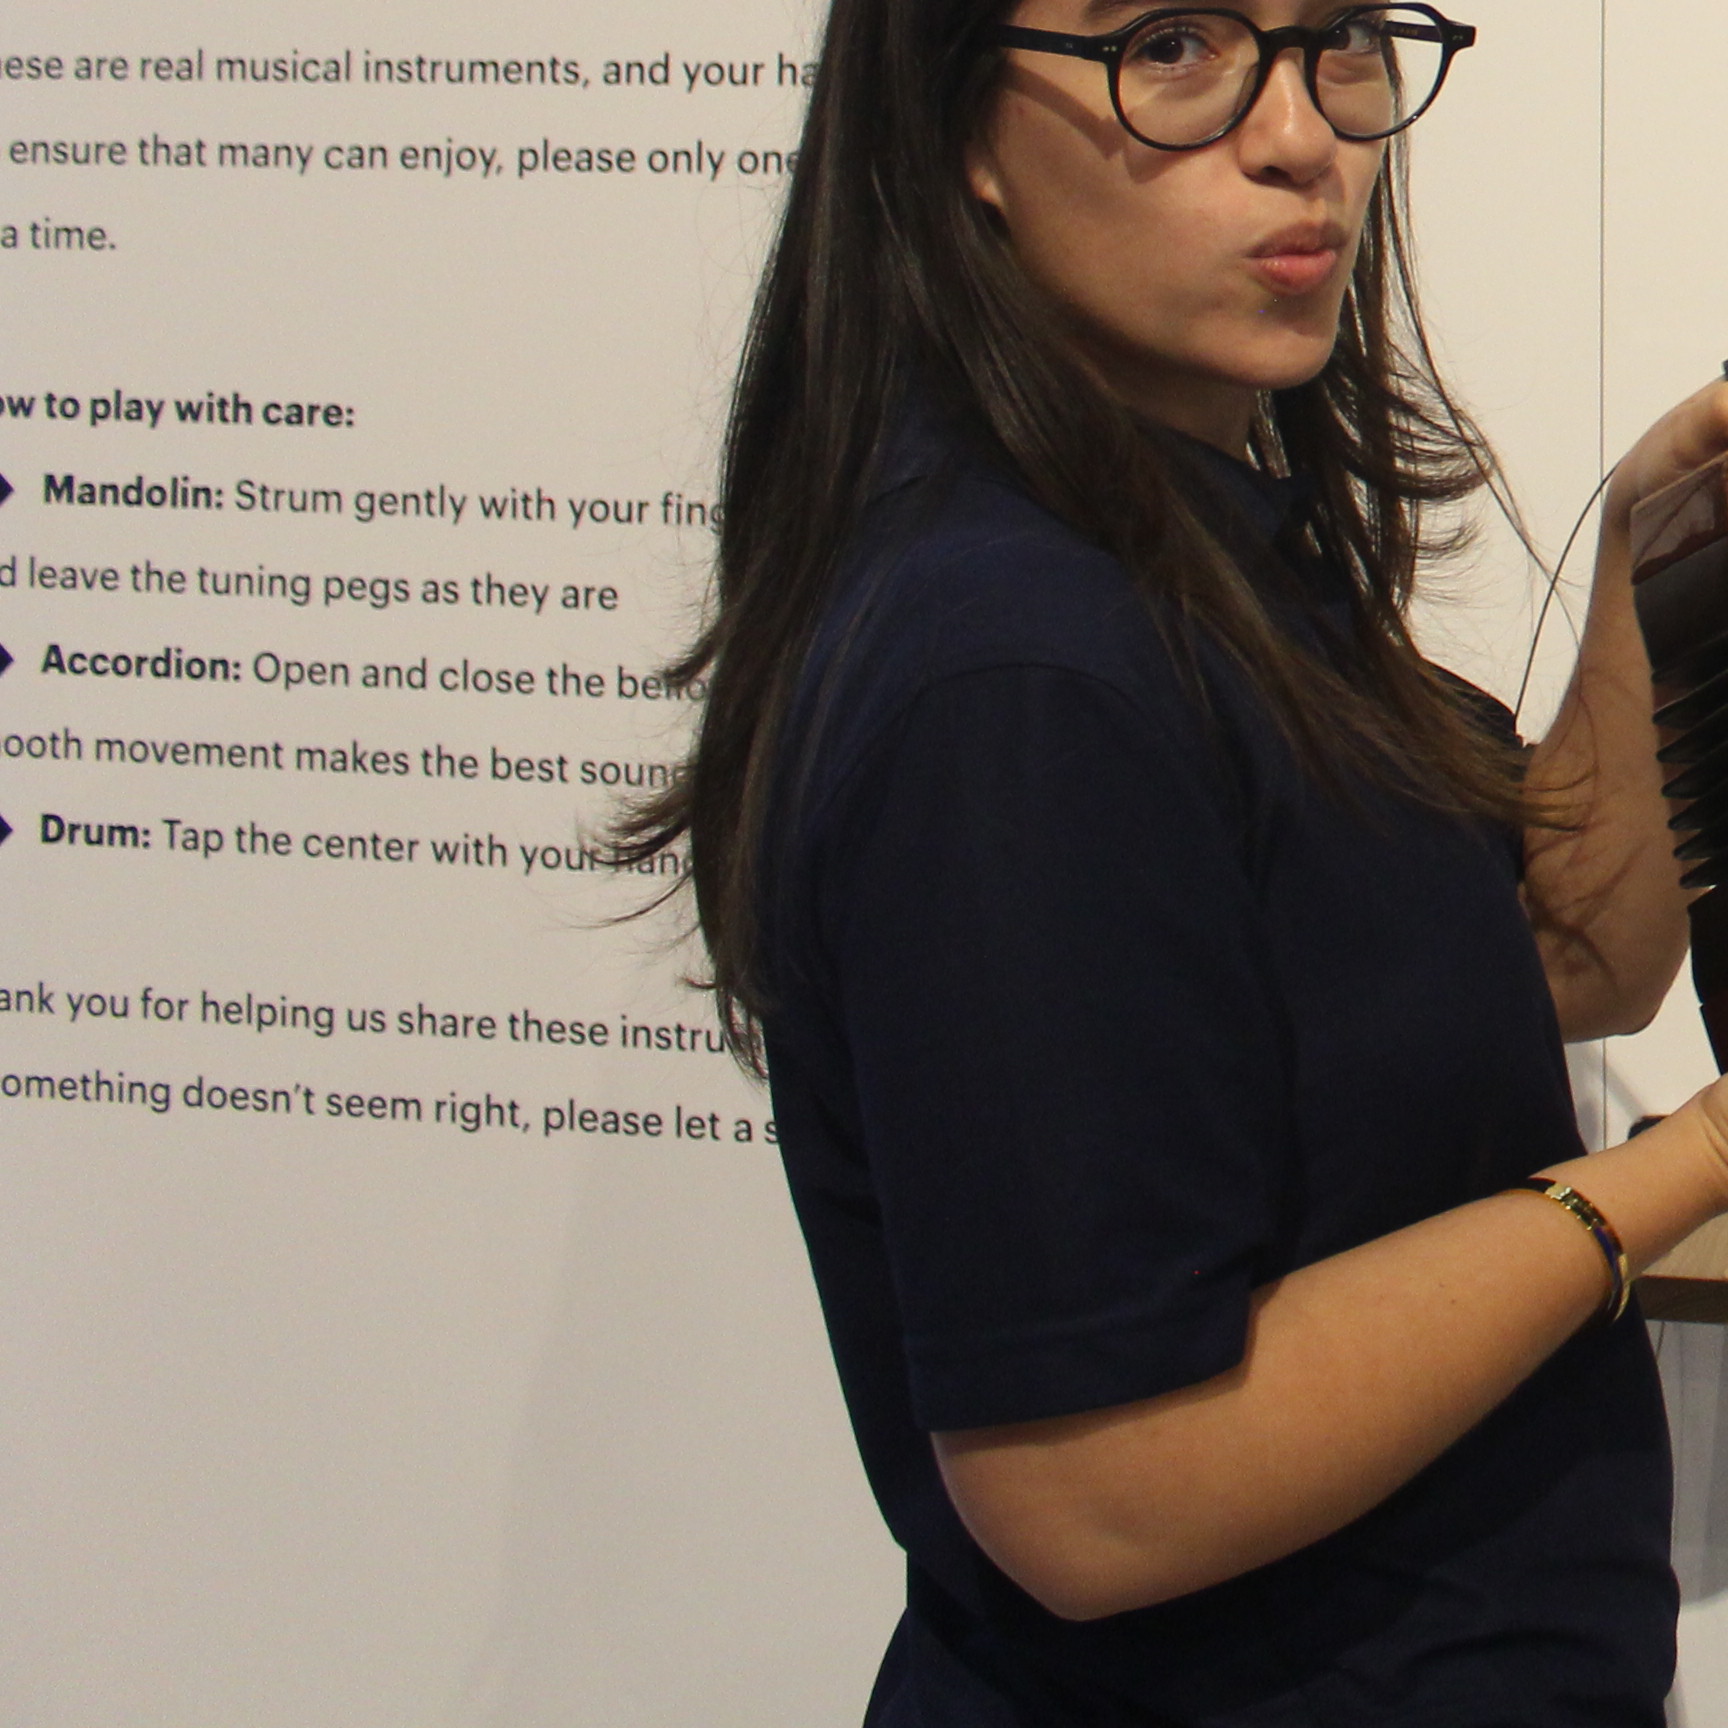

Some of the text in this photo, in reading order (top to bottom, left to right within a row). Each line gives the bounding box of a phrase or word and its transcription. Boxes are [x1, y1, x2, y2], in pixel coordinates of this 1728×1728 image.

[0, 55, 64, 81] ese
[73, 56, 129, 82] are
[140, 47, 204, 82] real
[216, 49, 352, 84] musical
[363, 49, 590, 89] instruments,
[602, 51, 671, 86] and
[682, 61, 766, 94] your
[8, 140, 128, 166] ensure
[137, 132, 207, 168] that
[218, 143, 314, 176] many
[323, 144, 388, 170] can
[399, 137, 504, 179] enjoy,
[517, 137, 637, 180] please
[647, 139, 726, 183] only
[0, 216, 116, 251] a time.
[43, 391, 82, 421] to
[89, 388, 166, 430] play
[173, 390, 254, 426] with
[261, 401, 355, 429] care:
[43, 472, 224, 511] Mandolin:
[234, 478, 343, 514] Strum
[354, 483, 468, 526] gently
[478, 486, 556, 522] with
[567, 498, 650, 530] your
[28, 555, 120, 592] leave
[130, 559, 187, 595] the
[196, 564, 312, 607] tuning
[323, 575, 411, 610] pegs
[420, 579, 460, 605] as
[470, 571, 550, 616] they
[560, 584, 619, 612] are
[40, 642, 242, 683] Accordion:
[252, 651, 350, 692] Open
[361, 656, 428, 690] and
[439, 658, 536, 695] close
[545, 662, 606, 698] the
[0, 727, 83, 761] ooth
[95, 737, 284, 771] movement
[295, 739, 410, 777] makes
[420, 743, 479, 780] the
[490, 746, 569, 784] best
[40, 812, 151, 850] Drum:
[161, 818, 225, 860] Tap
[234, 820, 292, 857] the
[302, 832, 421, 863] center
[430, 832, 508, 868] with
[66, 992, 130, 1023] you
[140, 986, 190, 1022] for
[200, 989, 335, 1039] helping
[346, 1008, 387, 1034] us
[397, 1001, 497, 1040] share
[507, 1008, 609, 1048] these
[326, 1092, 423, 1122] seem
[434, 1091, 531, 1134] right,
[543, 1097, 664, 1138] please
[675, 1104, 721, 1142] let
[733, 1118, 753, 1144] a
